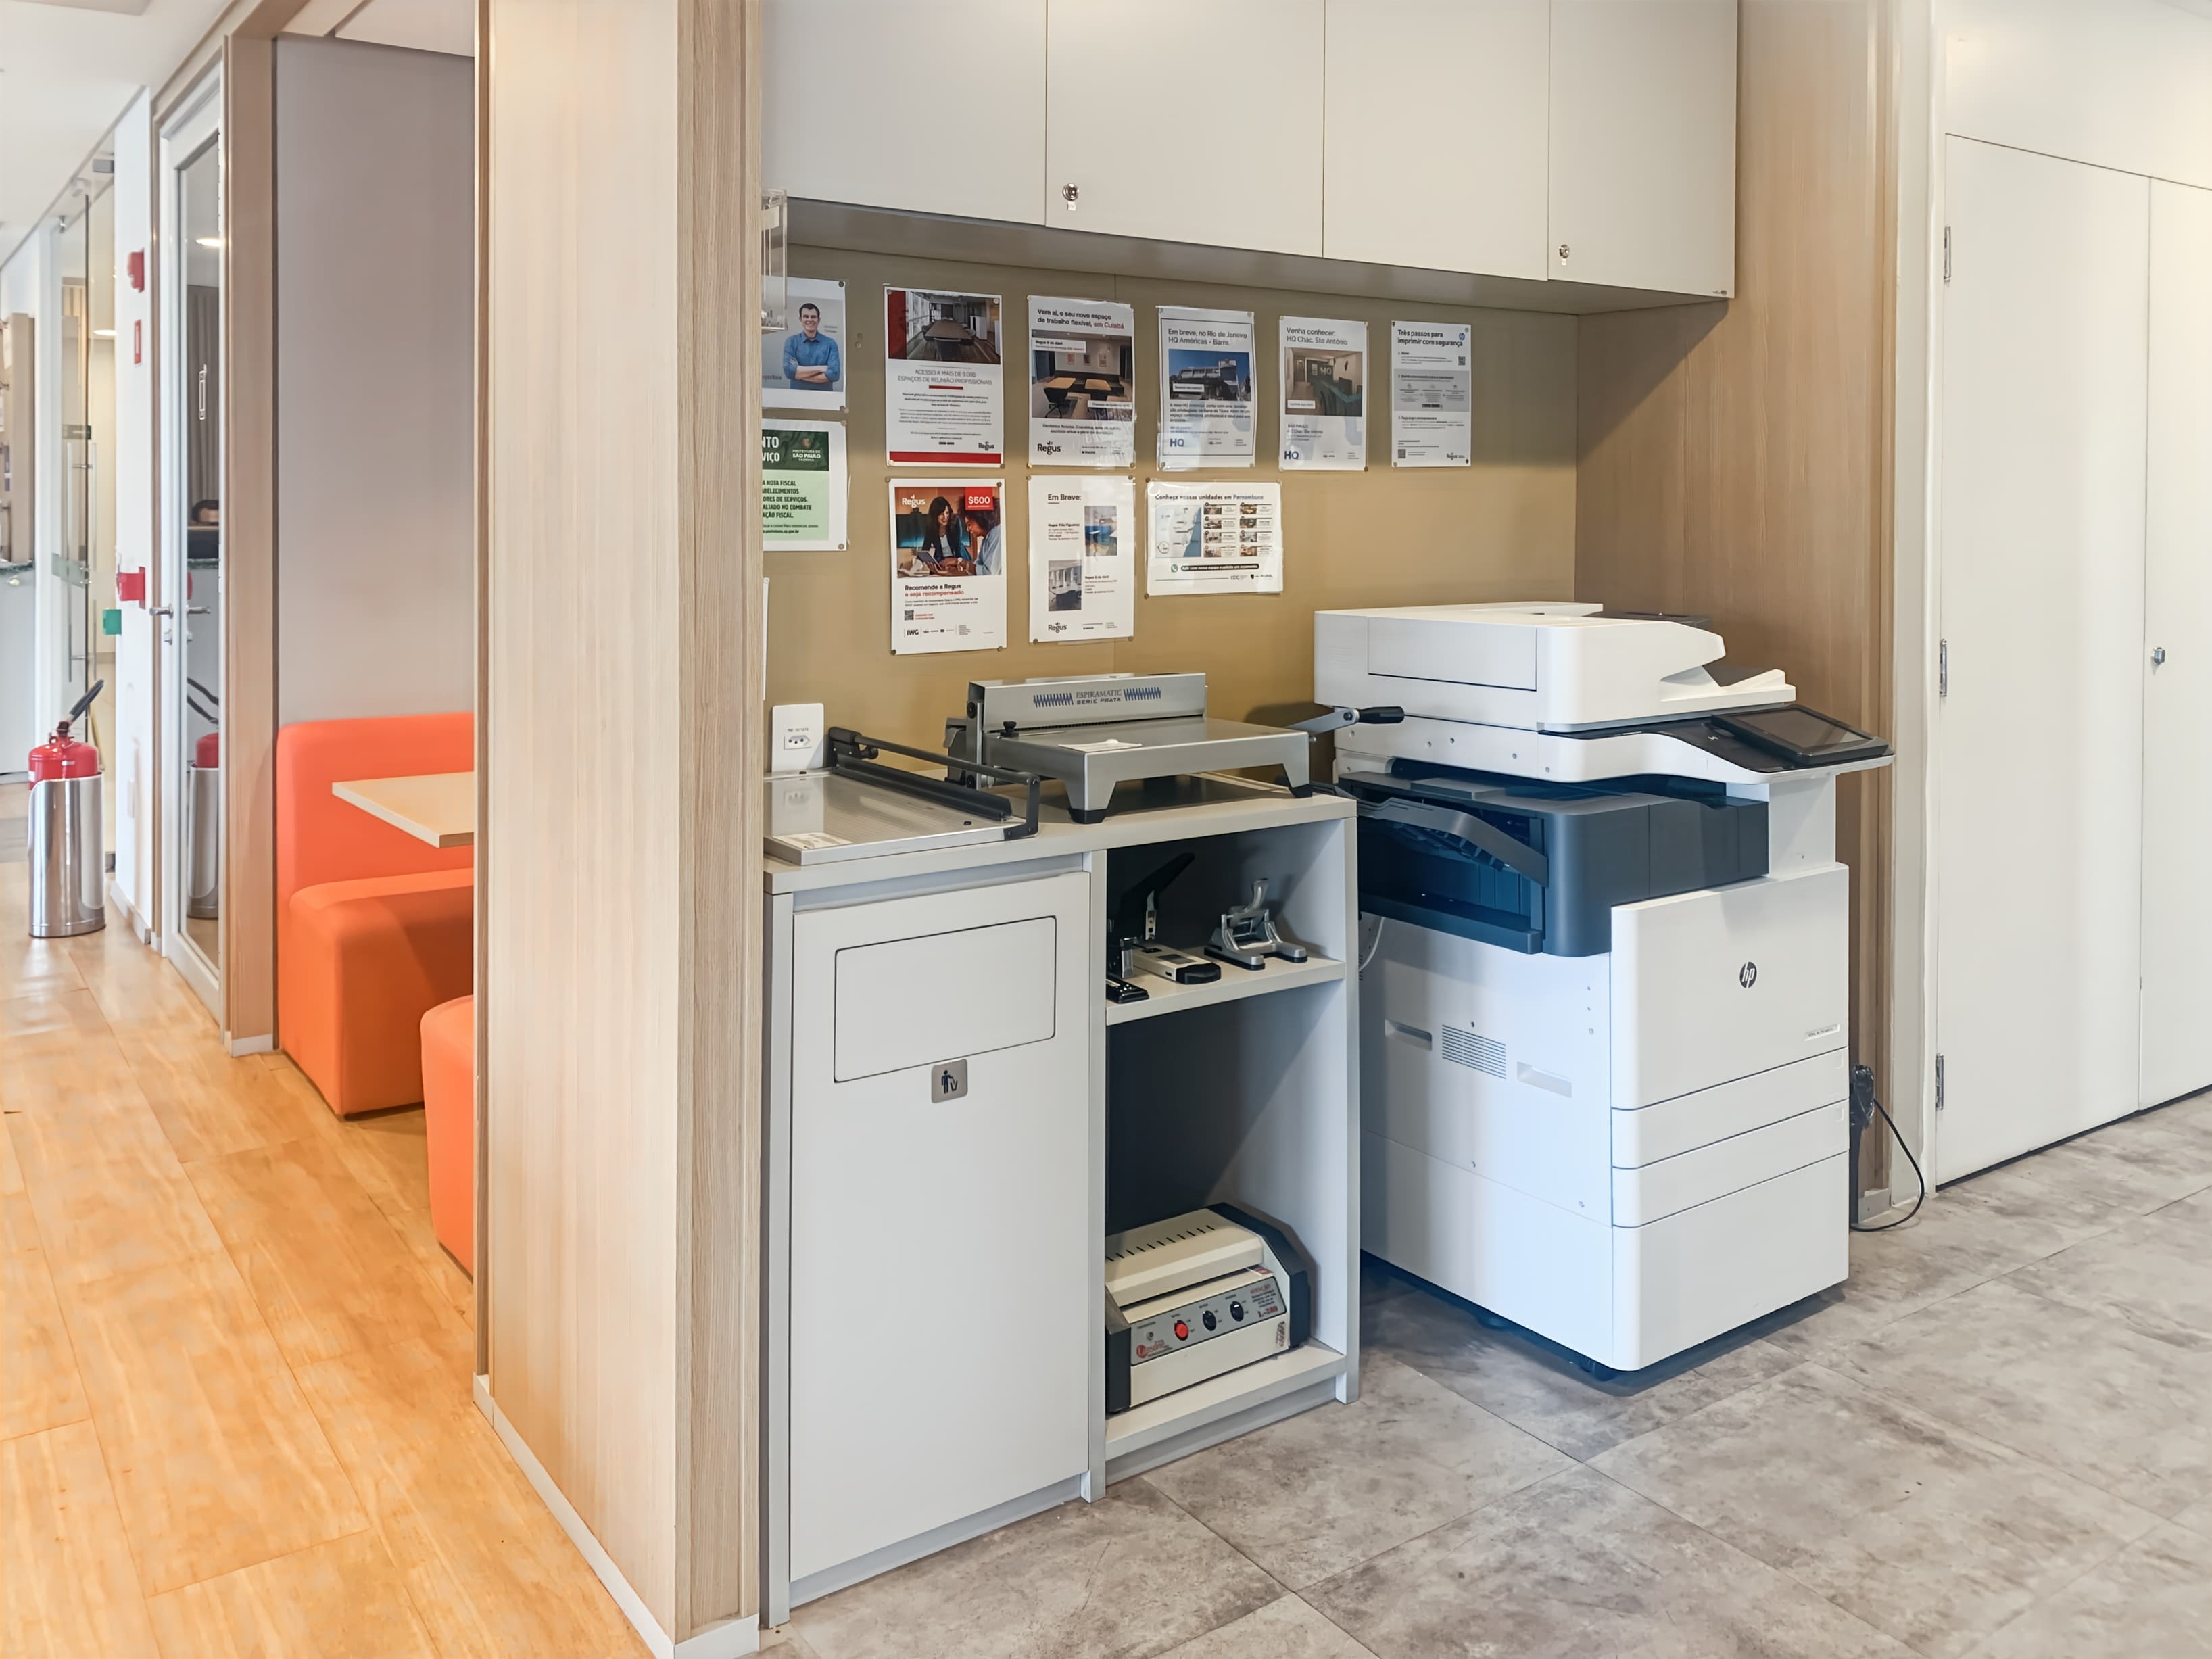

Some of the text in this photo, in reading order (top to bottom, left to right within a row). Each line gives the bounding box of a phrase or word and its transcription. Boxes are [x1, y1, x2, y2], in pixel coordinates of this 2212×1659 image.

[1179, 329, 1197, 337] breve,
[1287, 327, 1305, 335] Venha
[1411, 331, 1430, 339] passos
[1179, 337, 1207, 345] Américas
[1397, 337, 1422, 345] imprimir
[1435, 340, 1463, 348] segurança
[1037, 441, 1061, 455] Regus
[1170, 438, 1184, 448] HQ
[1284, 450, 1299, 460] HQ
[902, 495, 925, 508] Regus
[968, 496, 990, 505] $500
[1048, 623, 1067, 633] Regus
[1076, 690, 1122, 699] ESPIRAMATIC
[1740, 962, 1757, 988] hp
